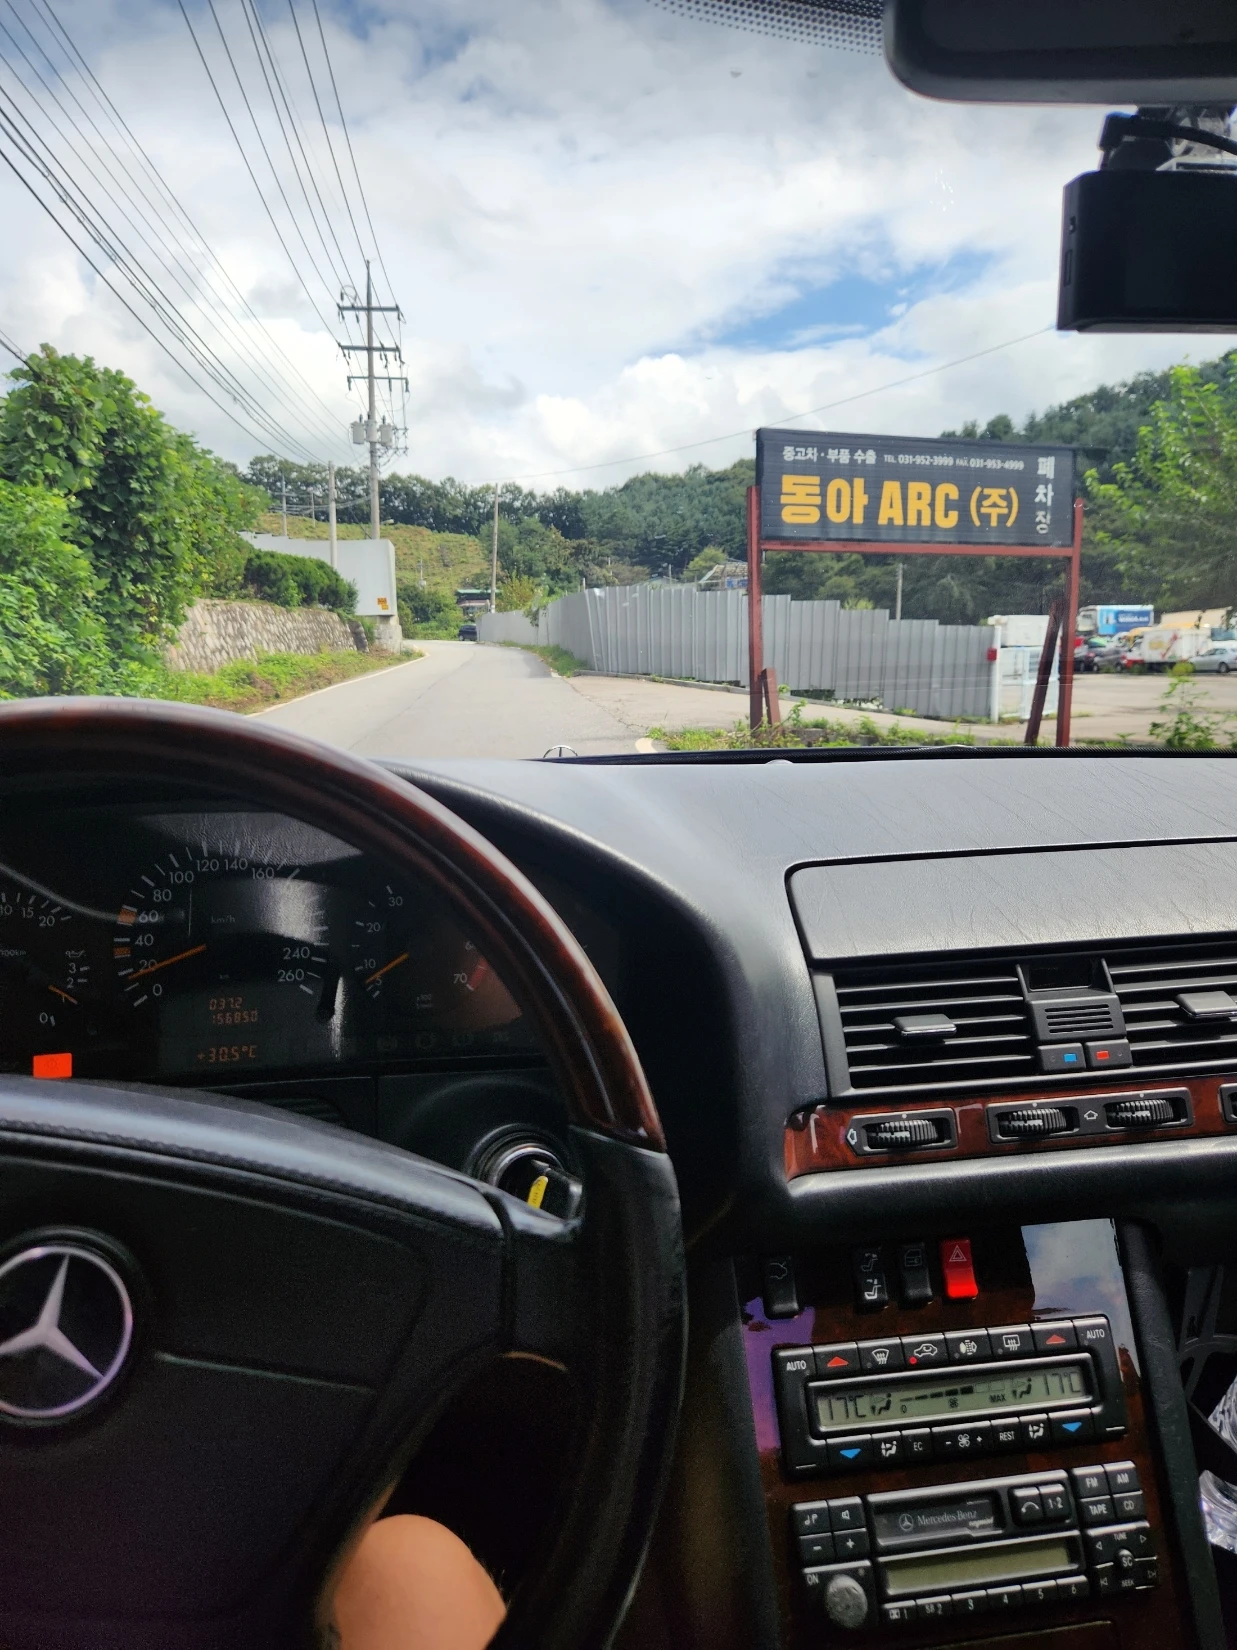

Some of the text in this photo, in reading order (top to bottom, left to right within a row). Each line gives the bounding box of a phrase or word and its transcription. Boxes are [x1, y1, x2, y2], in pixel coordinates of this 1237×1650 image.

[783, 446, 818, 463] 중고차
[827, 448, 851, 464] 부품
[780, 475, 1019, 529] 동아 ARC (주)
[196, 859, 220, 872] 120
[224, 857, 248, 871] 140
[169, 870, 194, 884] 100
[252, 867, 275, 880] 160
[153, 889, 172, 902] 80
[388, 896, 403, 907] 30
[22, 906, 35, 919] 15
[138, 910, 159, 923] 60
[38, 915, 55, 927] 20
[366, 922, 381, 933] 20
[134, 934, 154, 946] 40
[283, 946, 310, 960] 240
[69, 963, 77, 974] 3
[139, 958, 158, 972] 20
[364, 958, 377, 969] 10
[277, 969, 305, 982] 260
[453, 973, 468, 984] 70
[66, 977, 75, 989] 2
[152, 983, 163, 997] 0
[39, 1012, 49, 1024] 0
[1086, 1329, 1105, 1339] AUTO
[786, 1360, 807, 1371] AUTO
[990, 1393, 1006, 1404] MAX
[1000, 1431, 1016, 1441] REST
[913, 1441, 923, 1451] EC
[1085, 1477, 1099, 1488] FM
[1116, 1473, 1130, 1484] AM
[1089, 1503, 1108, 1515] TAPE
[1123, 1500, 1135, 1511] CD
[1121, 1556, 1133, 1568] SC
[806, 1574, 819, 1586] ON
[1003, 1593, 1009, 1604] 4
[1038, 1588, 1044, 1600] 5
